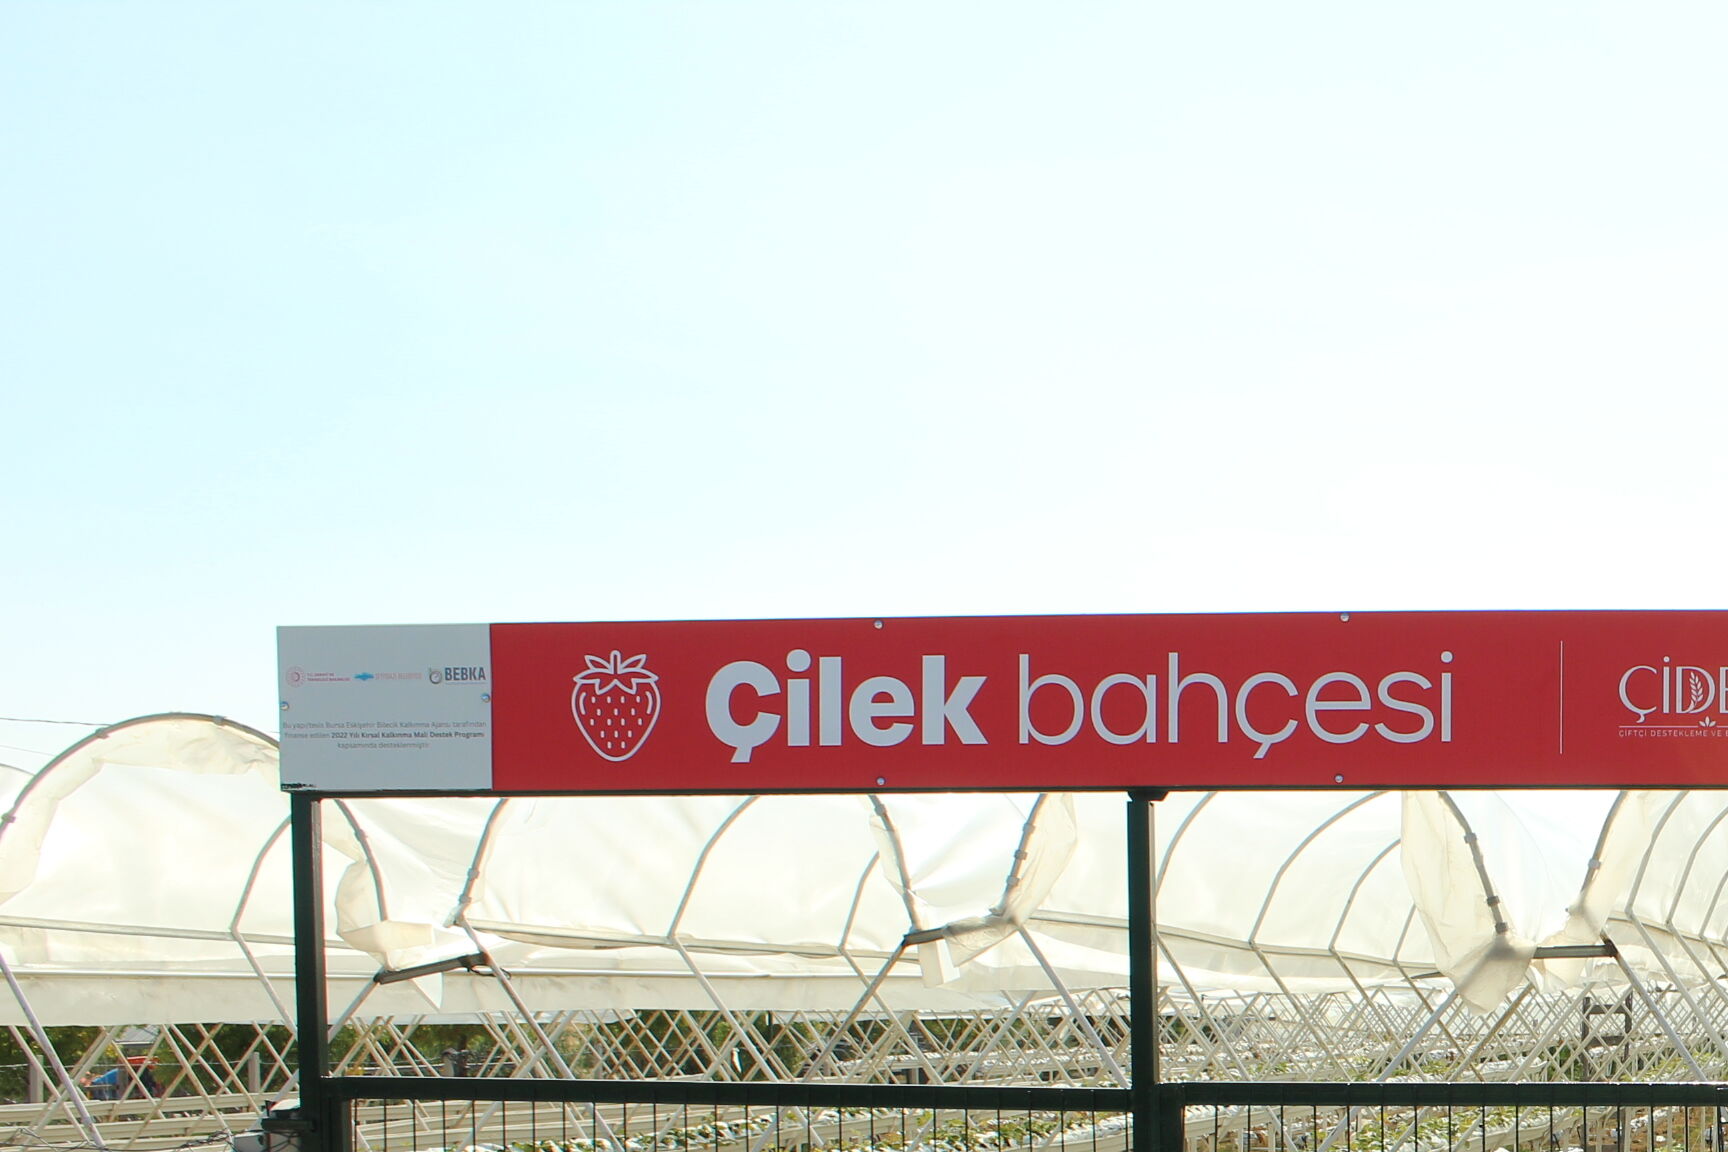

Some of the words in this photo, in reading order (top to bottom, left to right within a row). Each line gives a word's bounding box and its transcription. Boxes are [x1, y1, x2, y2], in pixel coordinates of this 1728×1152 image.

[444, 667, 487, 681] BEBKA
[705, 648, 989, 763] Çilek
[1018, 650, 1453, 759] bahçesi
[1650, 729, 1708, 737] DESTEKLEME
[1711, 729, 1722, 737] VE
